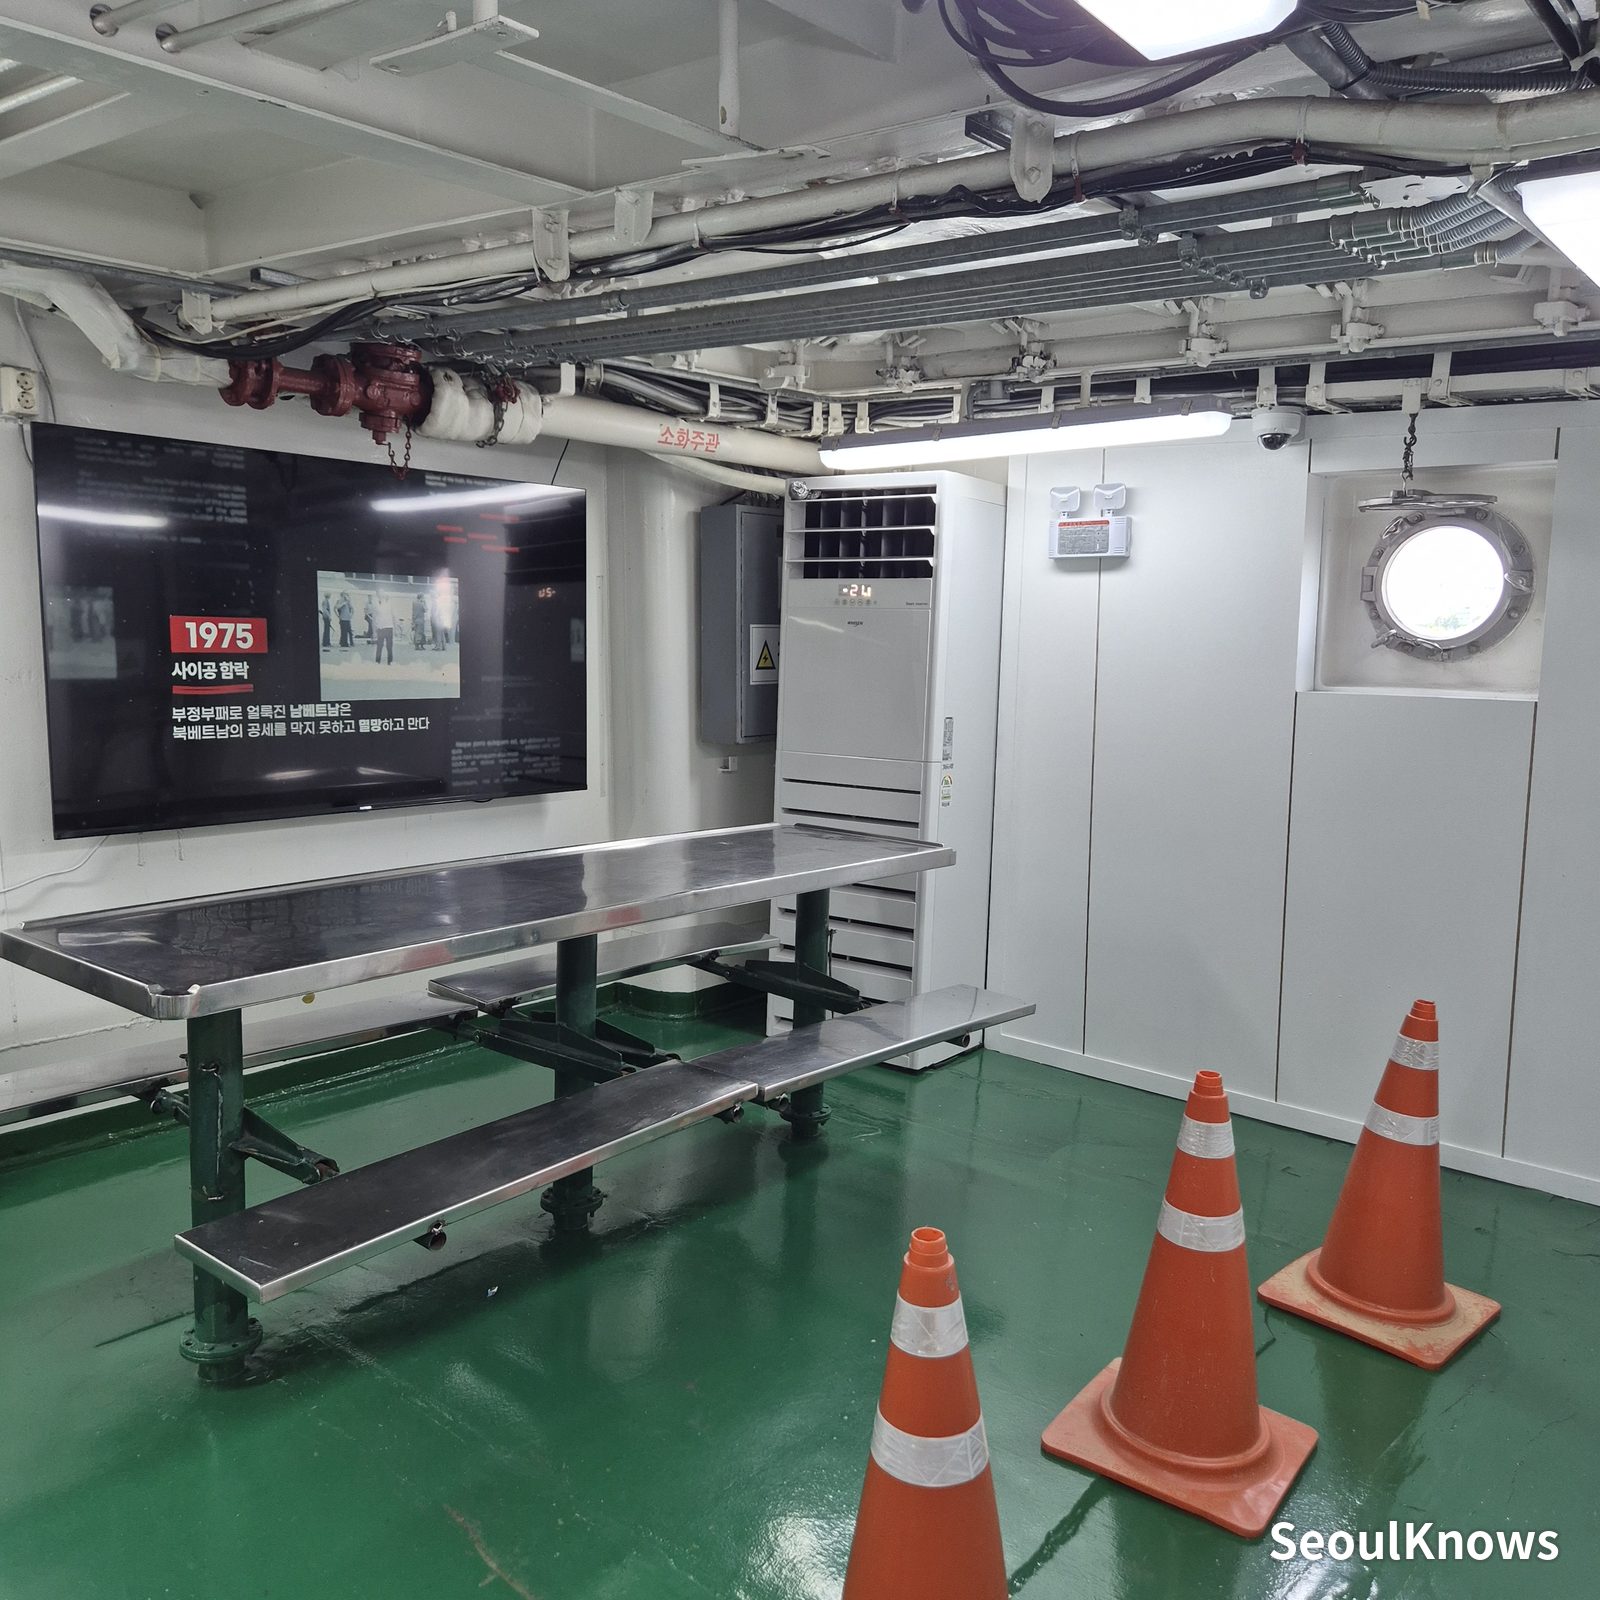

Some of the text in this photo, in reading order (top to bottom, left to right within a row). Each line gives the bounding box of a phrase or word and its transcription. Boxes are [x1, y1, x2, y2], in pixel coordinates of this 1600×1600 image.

[657, 426, 720, 453] 소화주관
[185, 622, 254, 649] 1975
[171, 661, 249, 680] 사이공 함락
[172, 703, 351, 722] 부정부패로 얼룩진 남베트남은
[173, 717, 430, 740] 북베트남의 공세를 막지 못하고 멸망하고 만다
